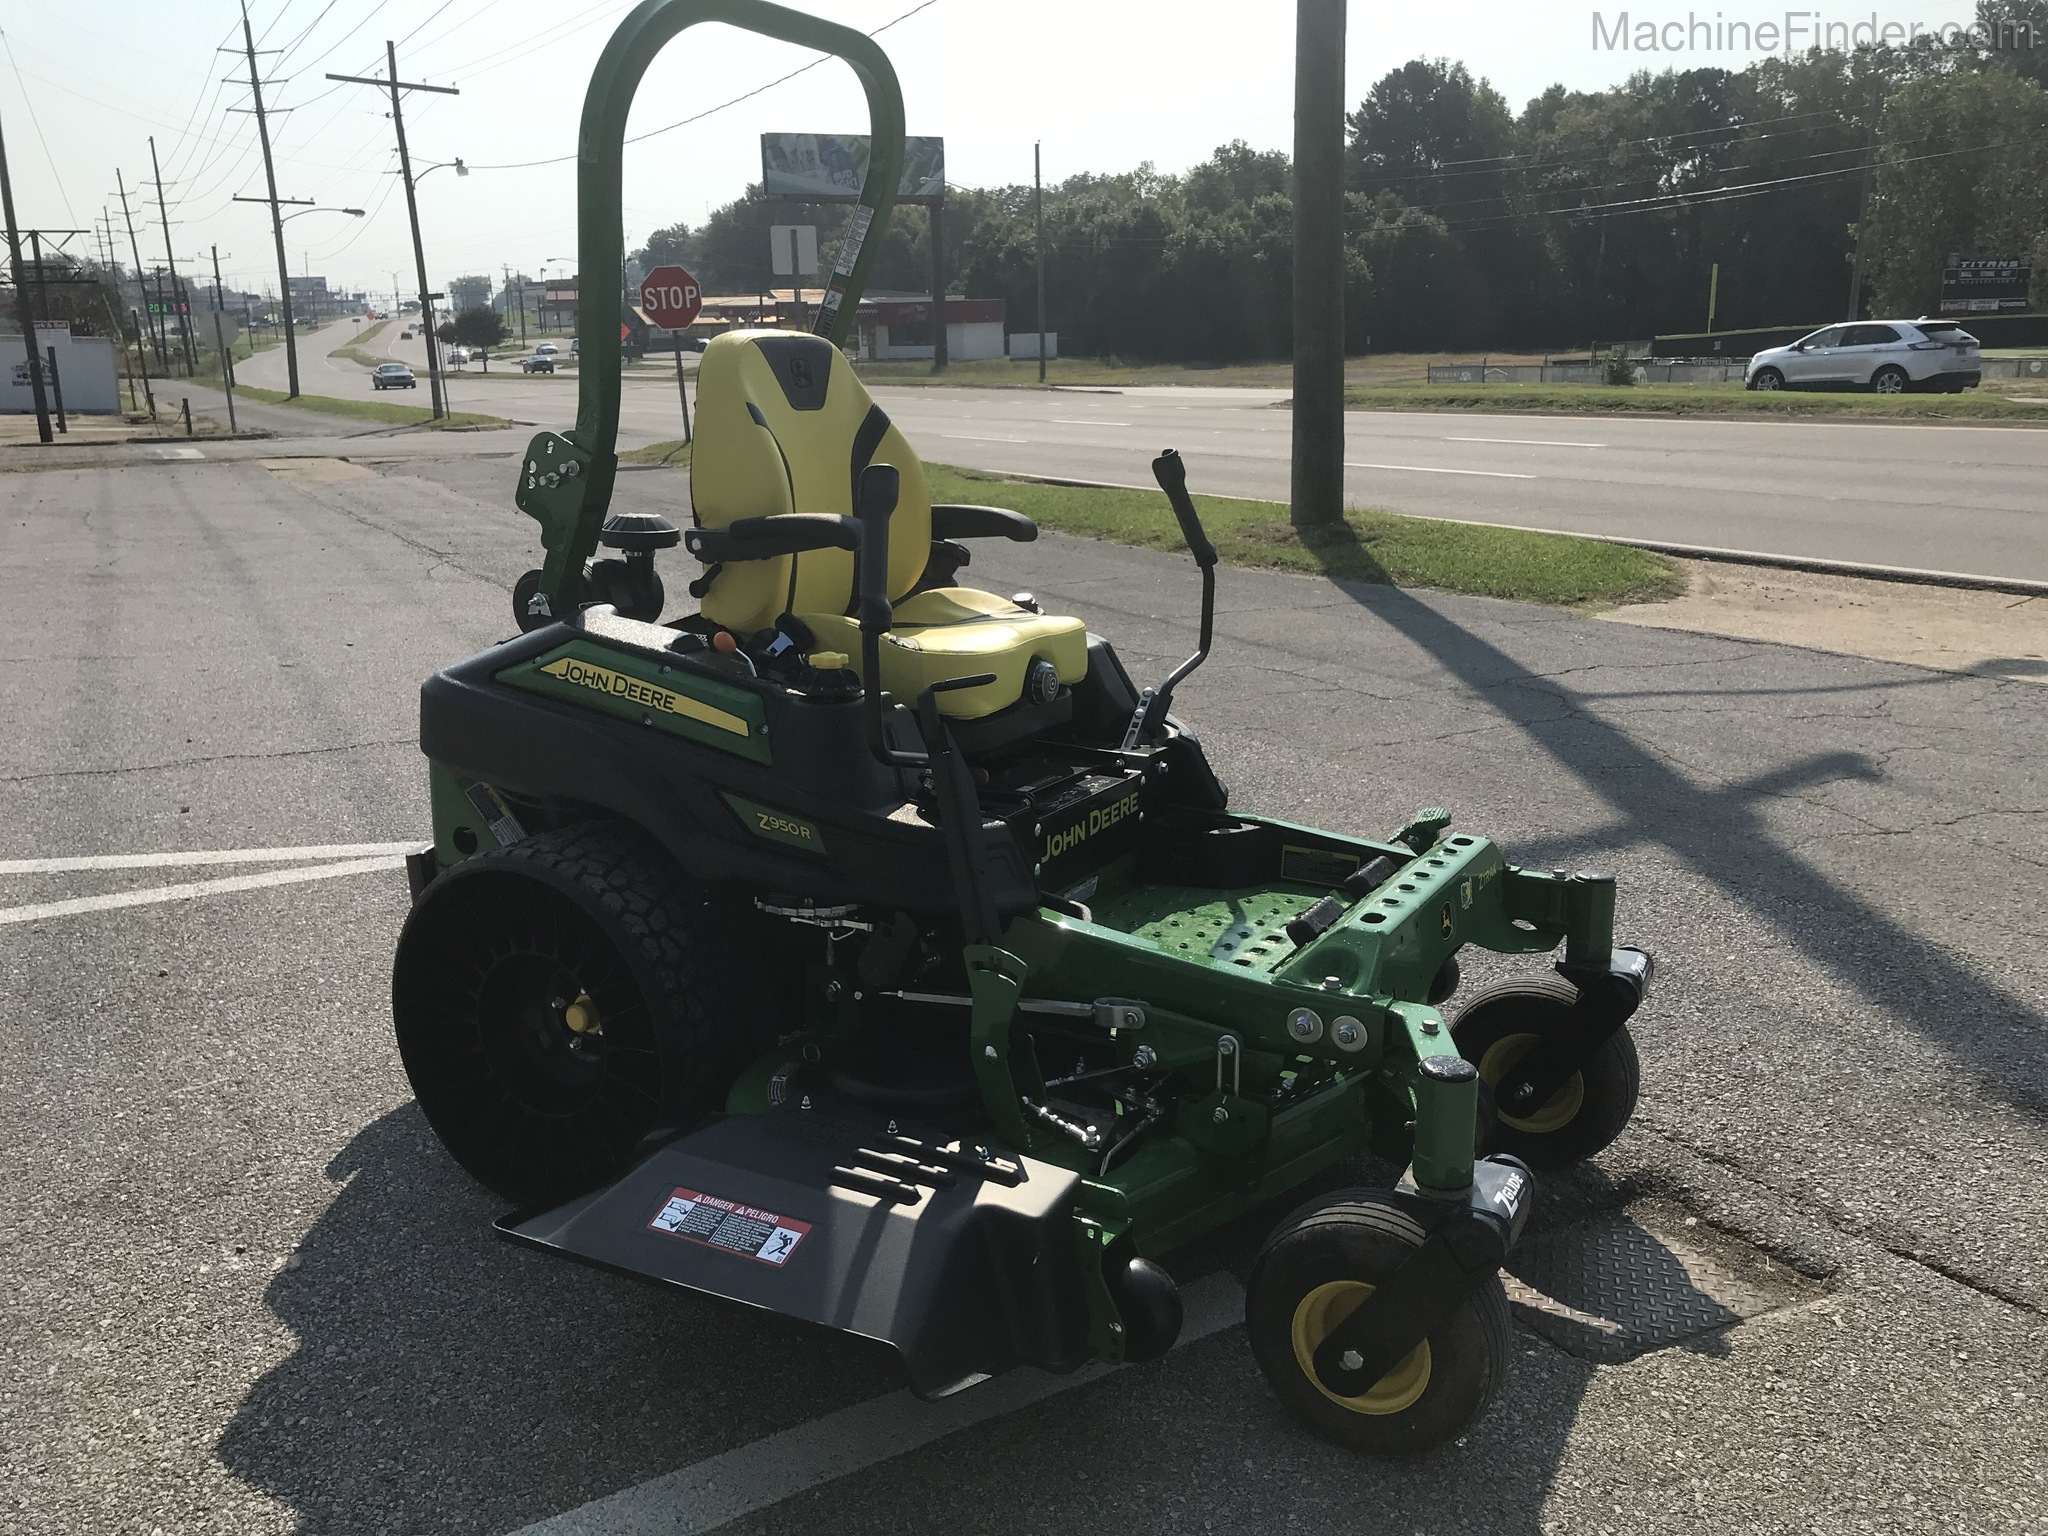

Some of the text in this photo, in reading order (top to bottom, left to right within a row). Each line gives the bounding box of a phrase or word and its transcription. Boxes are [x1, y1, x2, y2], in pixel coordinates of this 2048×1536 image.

[1960, 260, 2019, 268] TITANS
[644, 285, 698, 311] STOP
[558, 661, 676, 711] JOHN DEERE
[1041, 792, 1139, 864] JOHN DEERE
[702, 1196, 735, 1211] DANGER
[744, 1208, 780, 1224] PELIGRO
